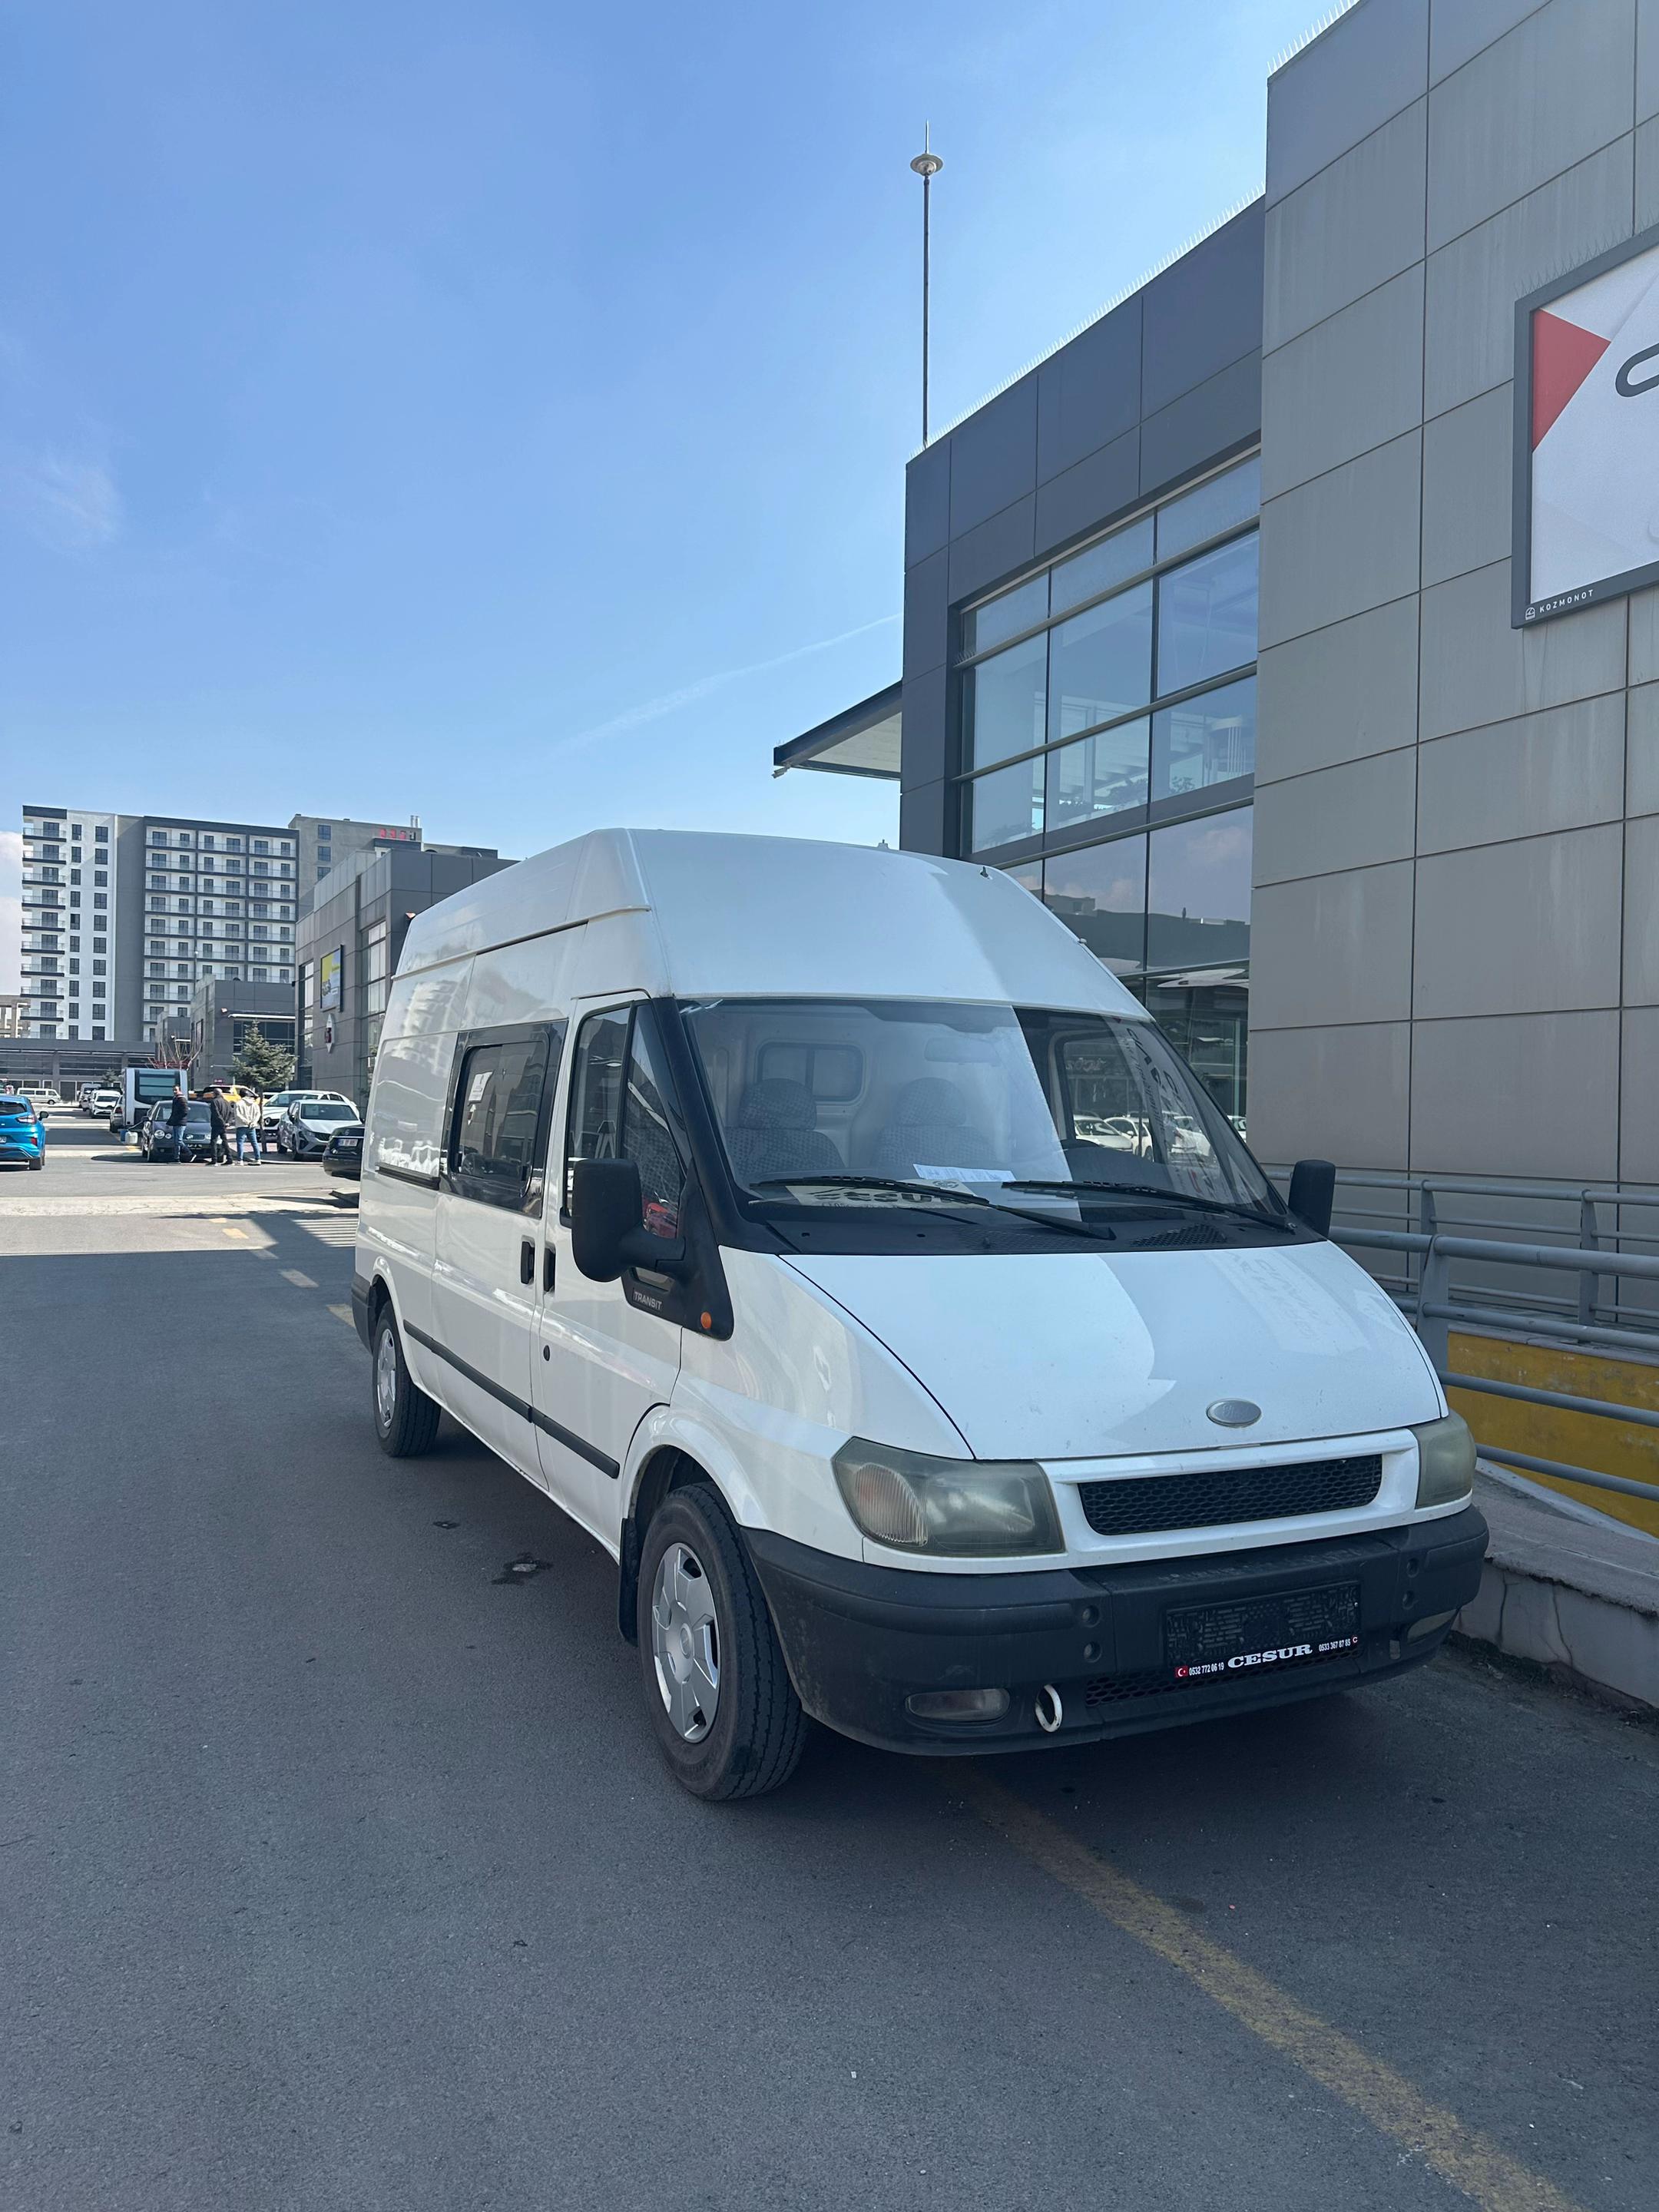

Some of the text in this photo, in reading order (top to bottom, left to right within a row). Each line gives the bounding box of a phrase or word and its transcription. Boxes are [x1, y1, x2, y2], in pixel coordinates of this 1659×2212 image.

[1539, 589, 1593, 613] KOZMONOT
[634, 1291, 662, 1310] TRANSIT
[1201, 1664, 1210, 1674] 772
[1218, 1661, 1224, 1671] 19
[1228, 1644, 1313, 1668] CESUR
